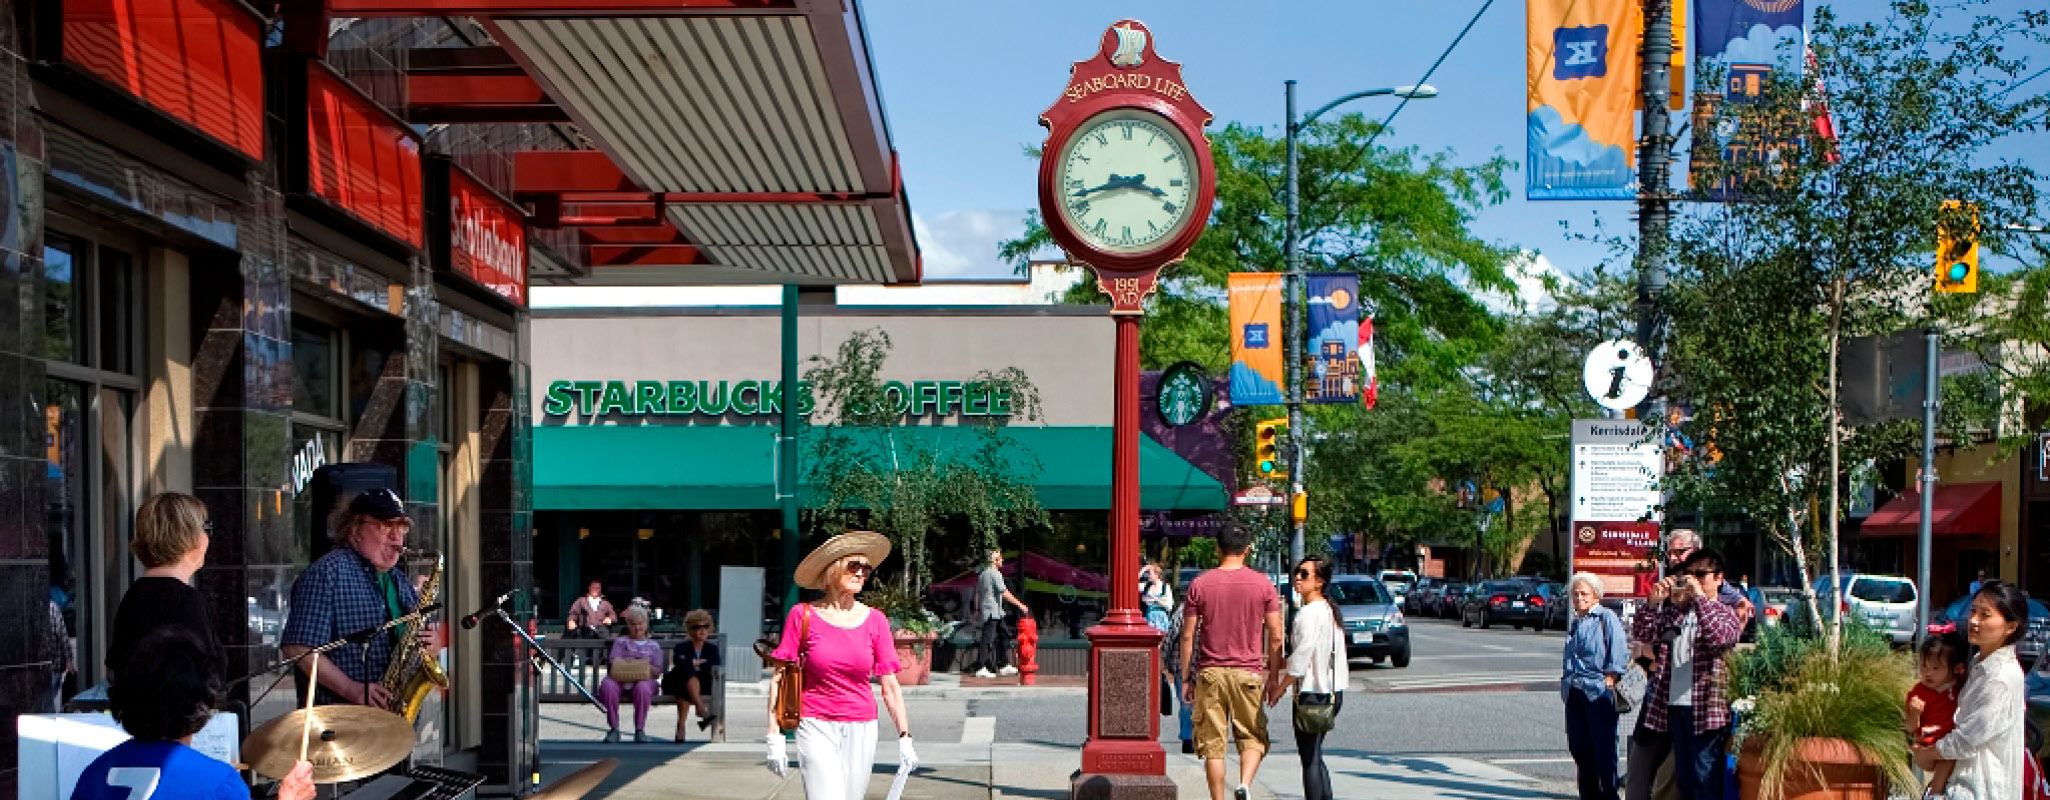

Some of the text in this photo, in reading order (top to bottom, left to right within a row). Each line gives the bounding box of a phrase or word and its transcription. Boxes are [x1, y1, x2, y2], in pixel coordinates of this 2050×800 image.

[1065, 73, 1184, 103] SEABOARD LIFE
[451, 195, 524, 285] Scotiabank
[545, 380, 816, 415] STARBUCKS
